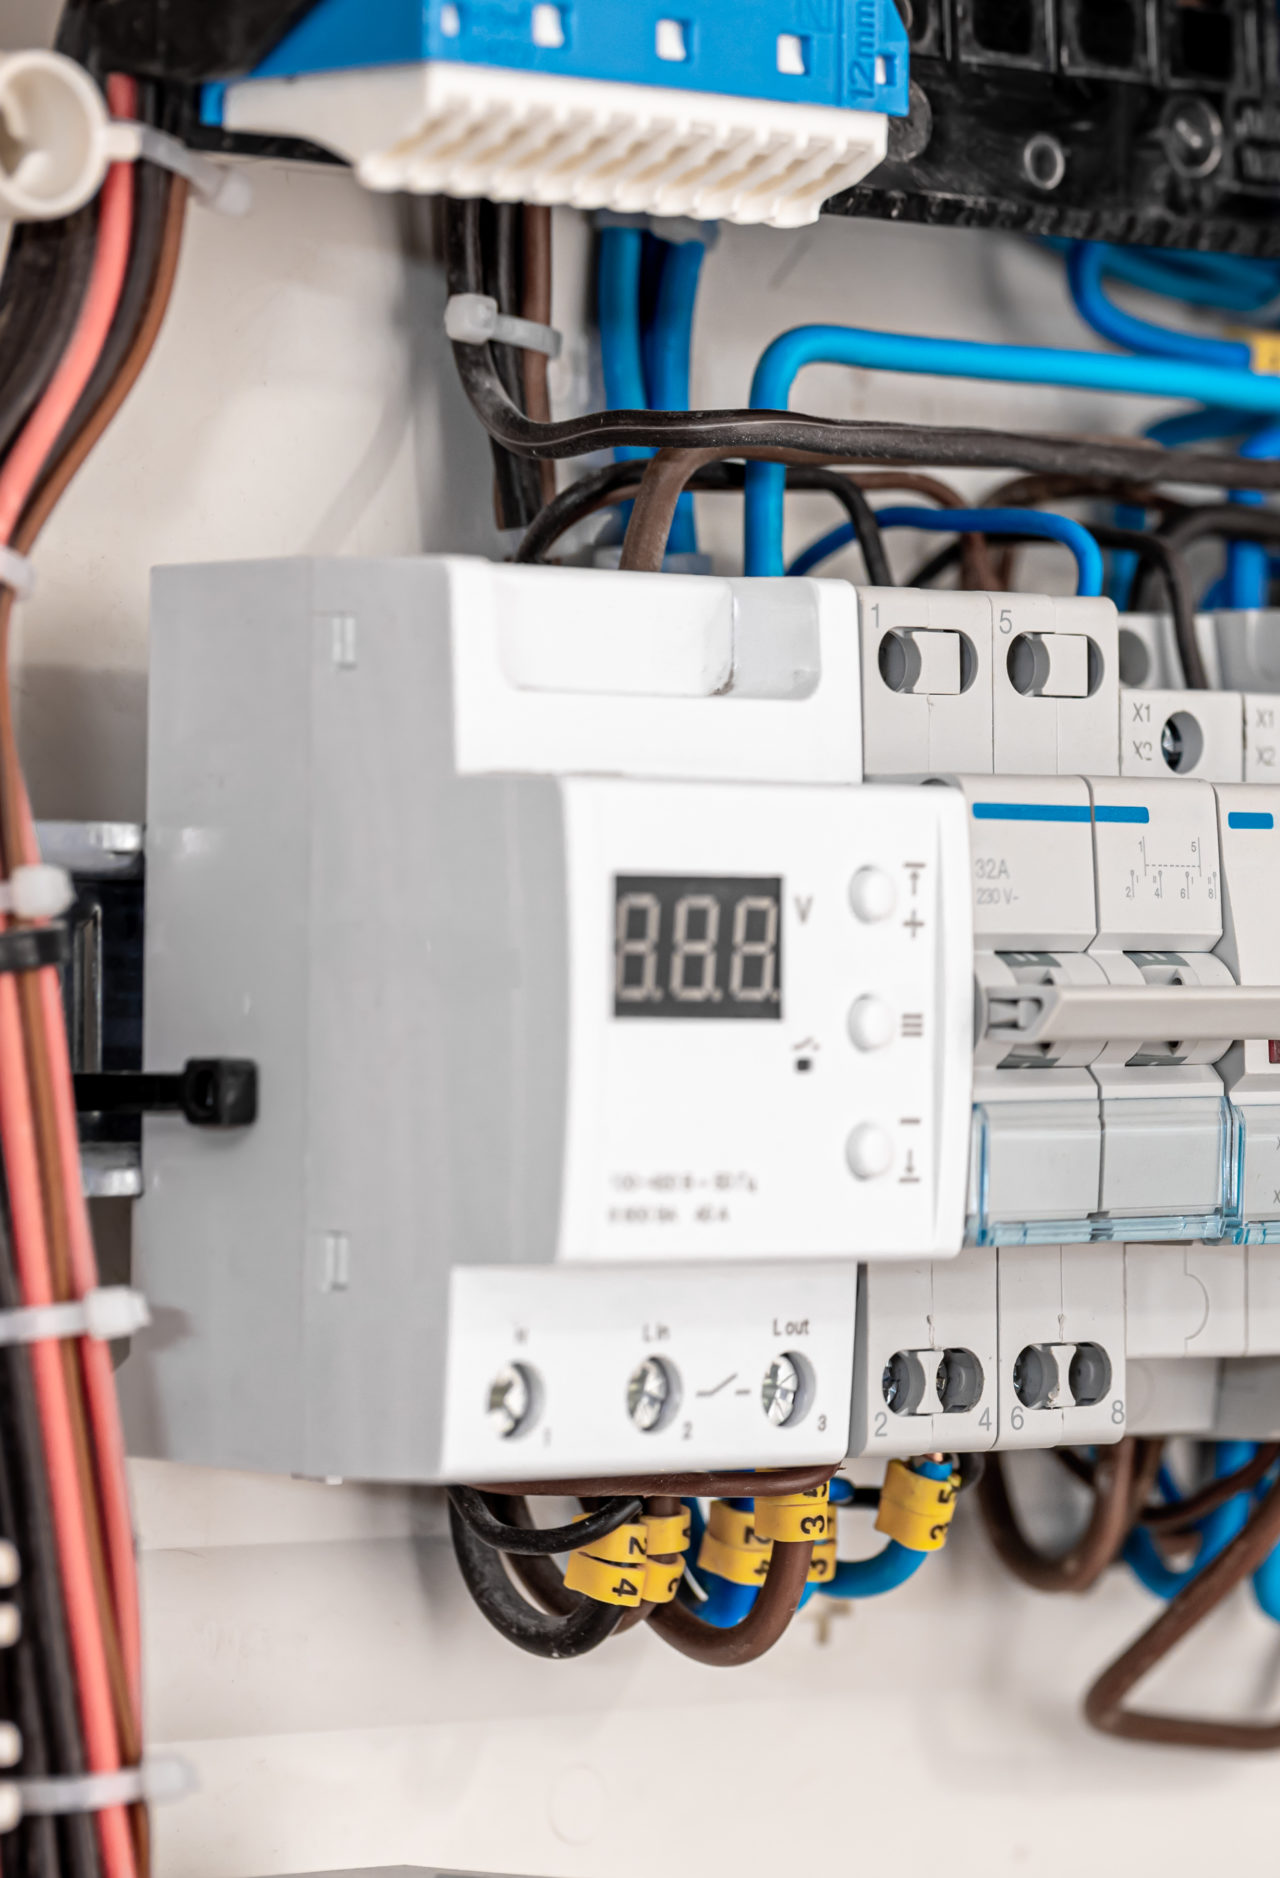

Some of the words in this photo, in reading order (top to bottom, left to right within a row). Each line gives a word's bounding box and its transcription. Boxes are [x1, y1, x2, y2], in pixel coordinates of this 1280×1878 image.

[871, 603, 880, 628] 1
[999, 609, 1013, 634] 5
[1132, 702, 1150, 722] X1
[1191, 841, 1198, 852] 5
[975, 858, 1010, 880] 32A
[977, 887, 1000, 905] 230
[794, 895, 814, 925] V
[818, 1414, 827, 1432] 3
[978, 1407, 993, 1432] 4
[1010, 1405, 1025, 1430] 6
[1111, 1400, 1125, 1425] 8
[874, 1411, 888, 1437] 2
[800, 1514, 825, 1534] 3
[629, 1536, 647, 1556] 2
[612, 1578, 638, 1597] 4
